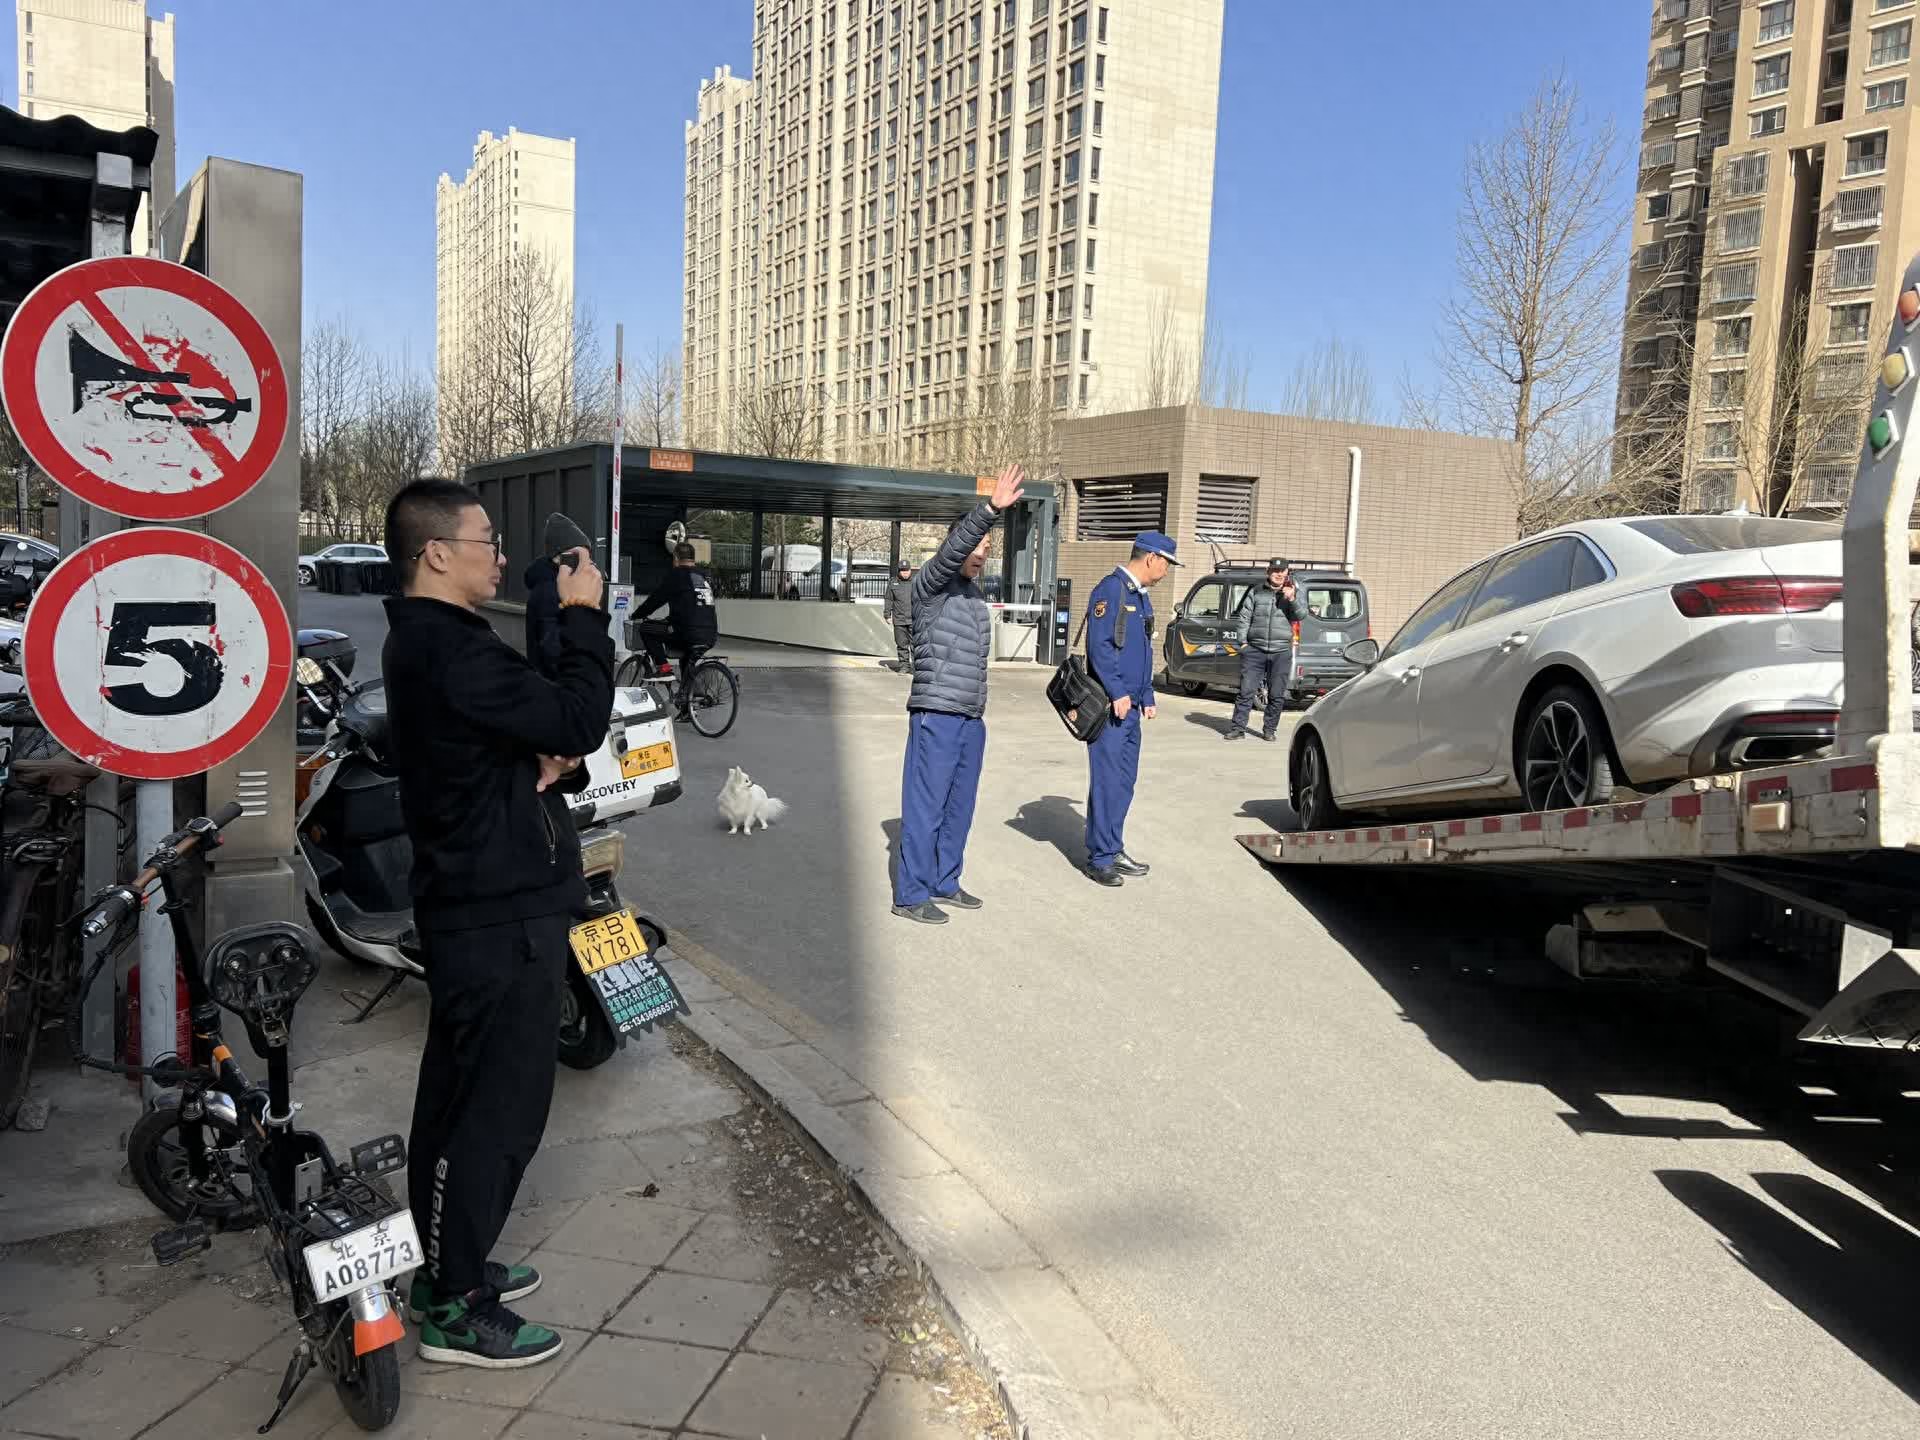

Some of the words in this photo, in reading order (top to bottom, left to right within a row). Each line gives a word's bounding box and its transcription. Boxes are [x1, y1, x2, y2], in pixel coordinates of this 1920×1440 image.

[104, 601, 224, 715] 5
[581, 932, 640, 968] VY781
[325, 1241, 414, 1294] A08773
